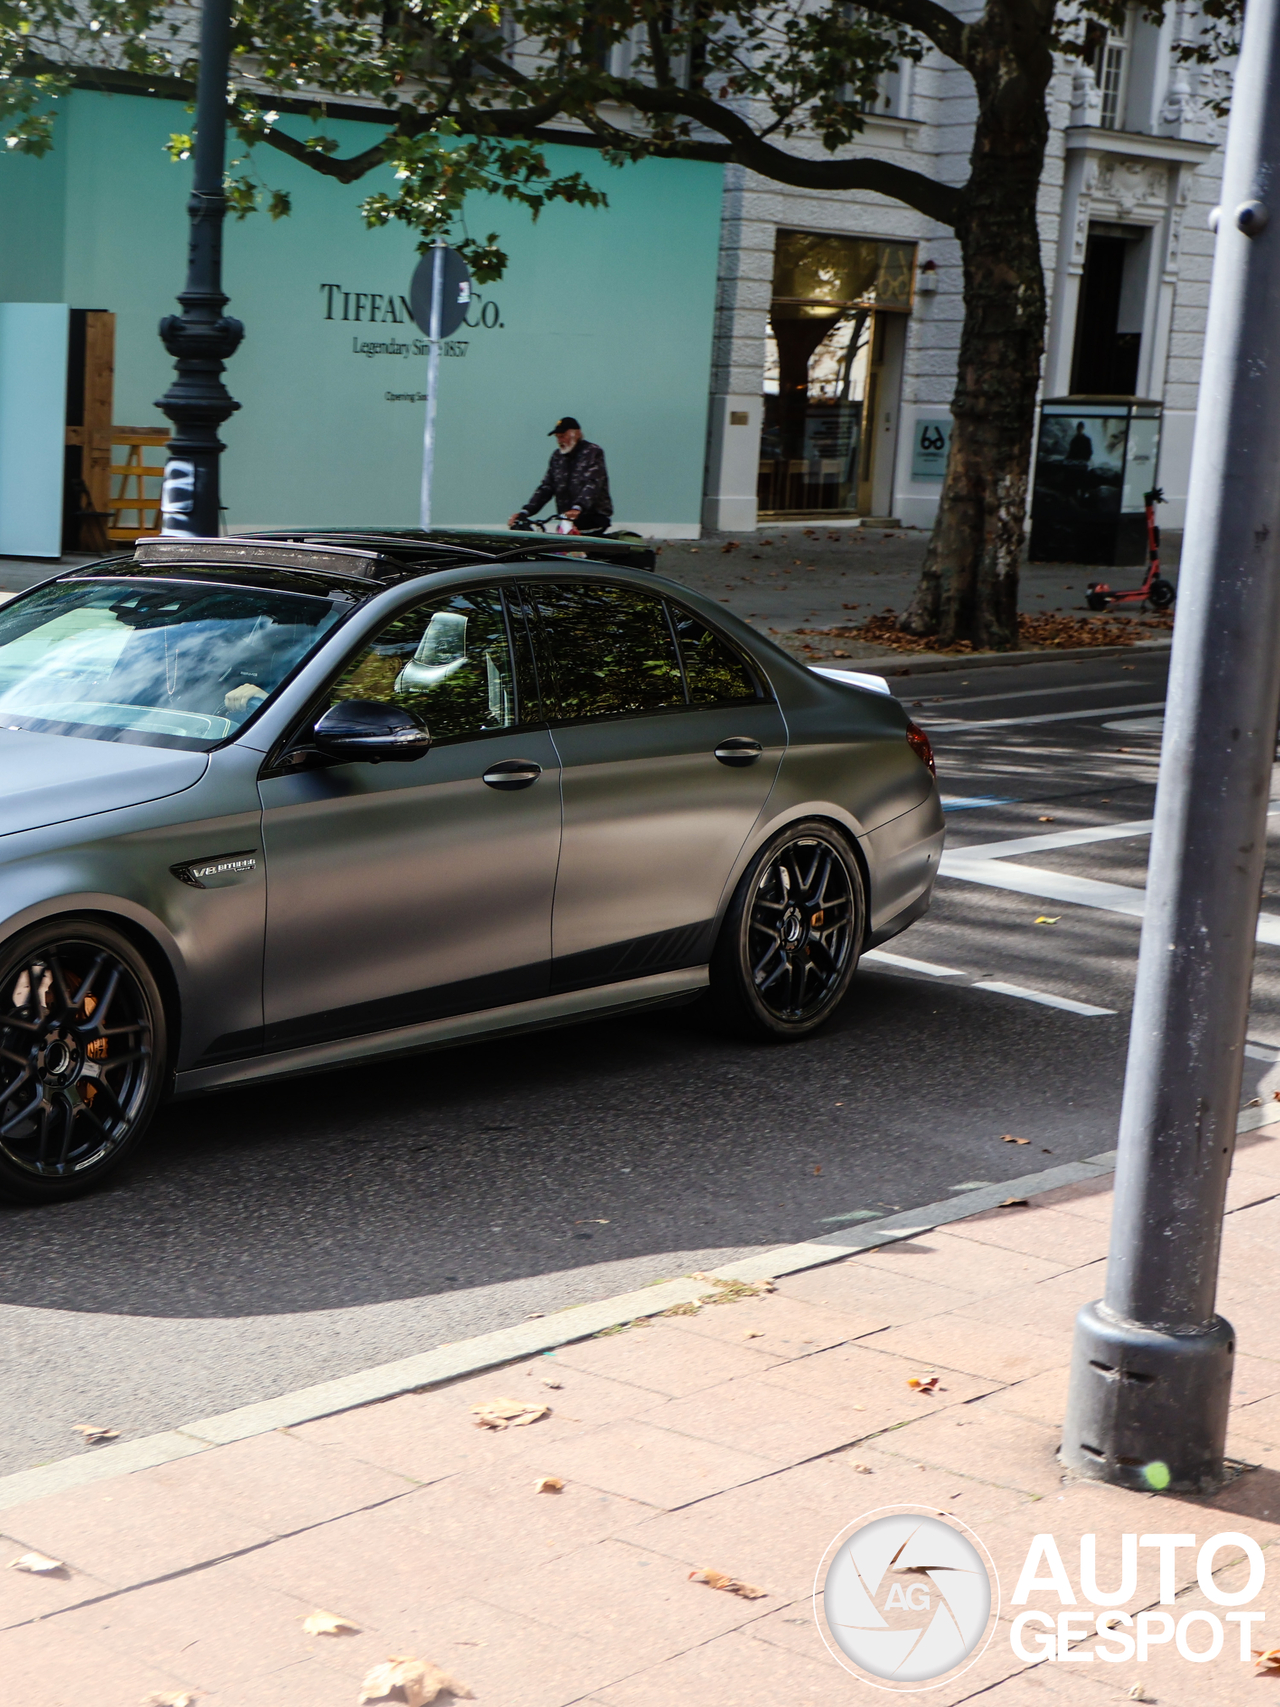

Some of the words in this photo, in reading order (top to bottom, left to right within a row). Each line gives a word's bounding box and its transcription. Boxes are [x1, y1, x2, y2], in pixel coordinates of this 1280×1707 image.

[321, 283, 414, 324] TIFFAN
[353, 336, 410, 359] Legendary
[412, 338, 442, 356] Sine
[384, 391, 415, 403] Opening
[193, 866, 217, 878] V8
